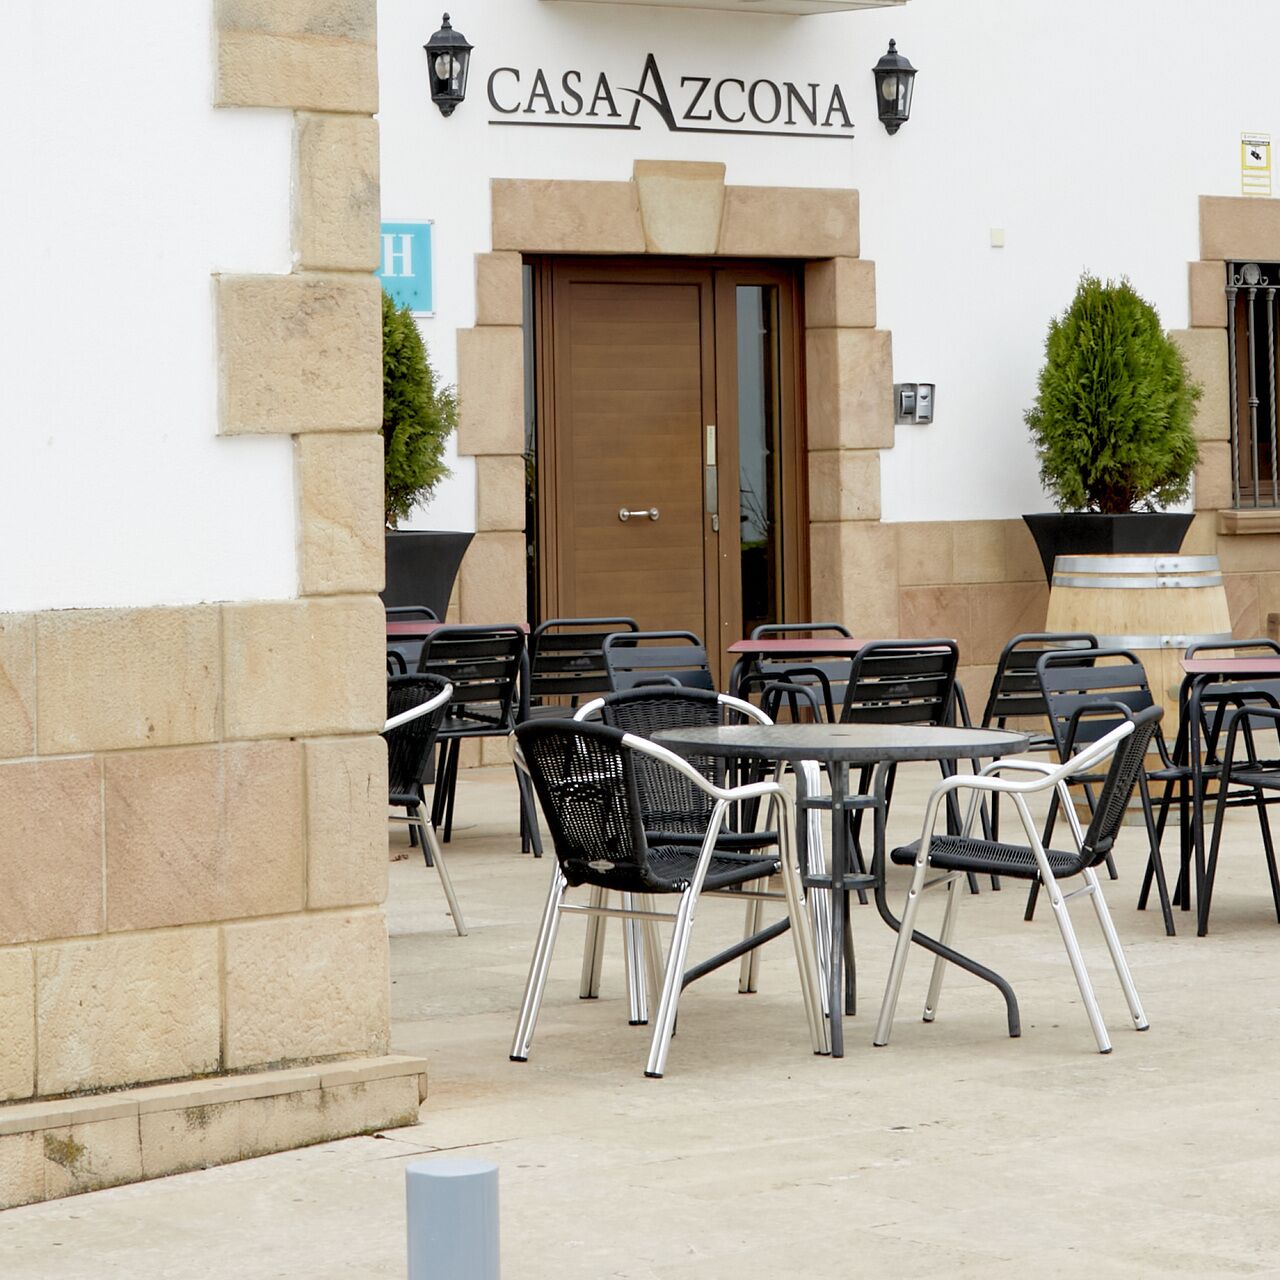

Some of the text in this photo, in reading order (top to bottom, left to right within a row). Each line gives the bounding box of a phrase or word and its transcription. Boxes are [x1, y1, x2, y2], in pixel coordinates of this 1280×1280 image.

[487, 53, 854, 131] CASA AZCONA
[381, 234, 415, 277] H
